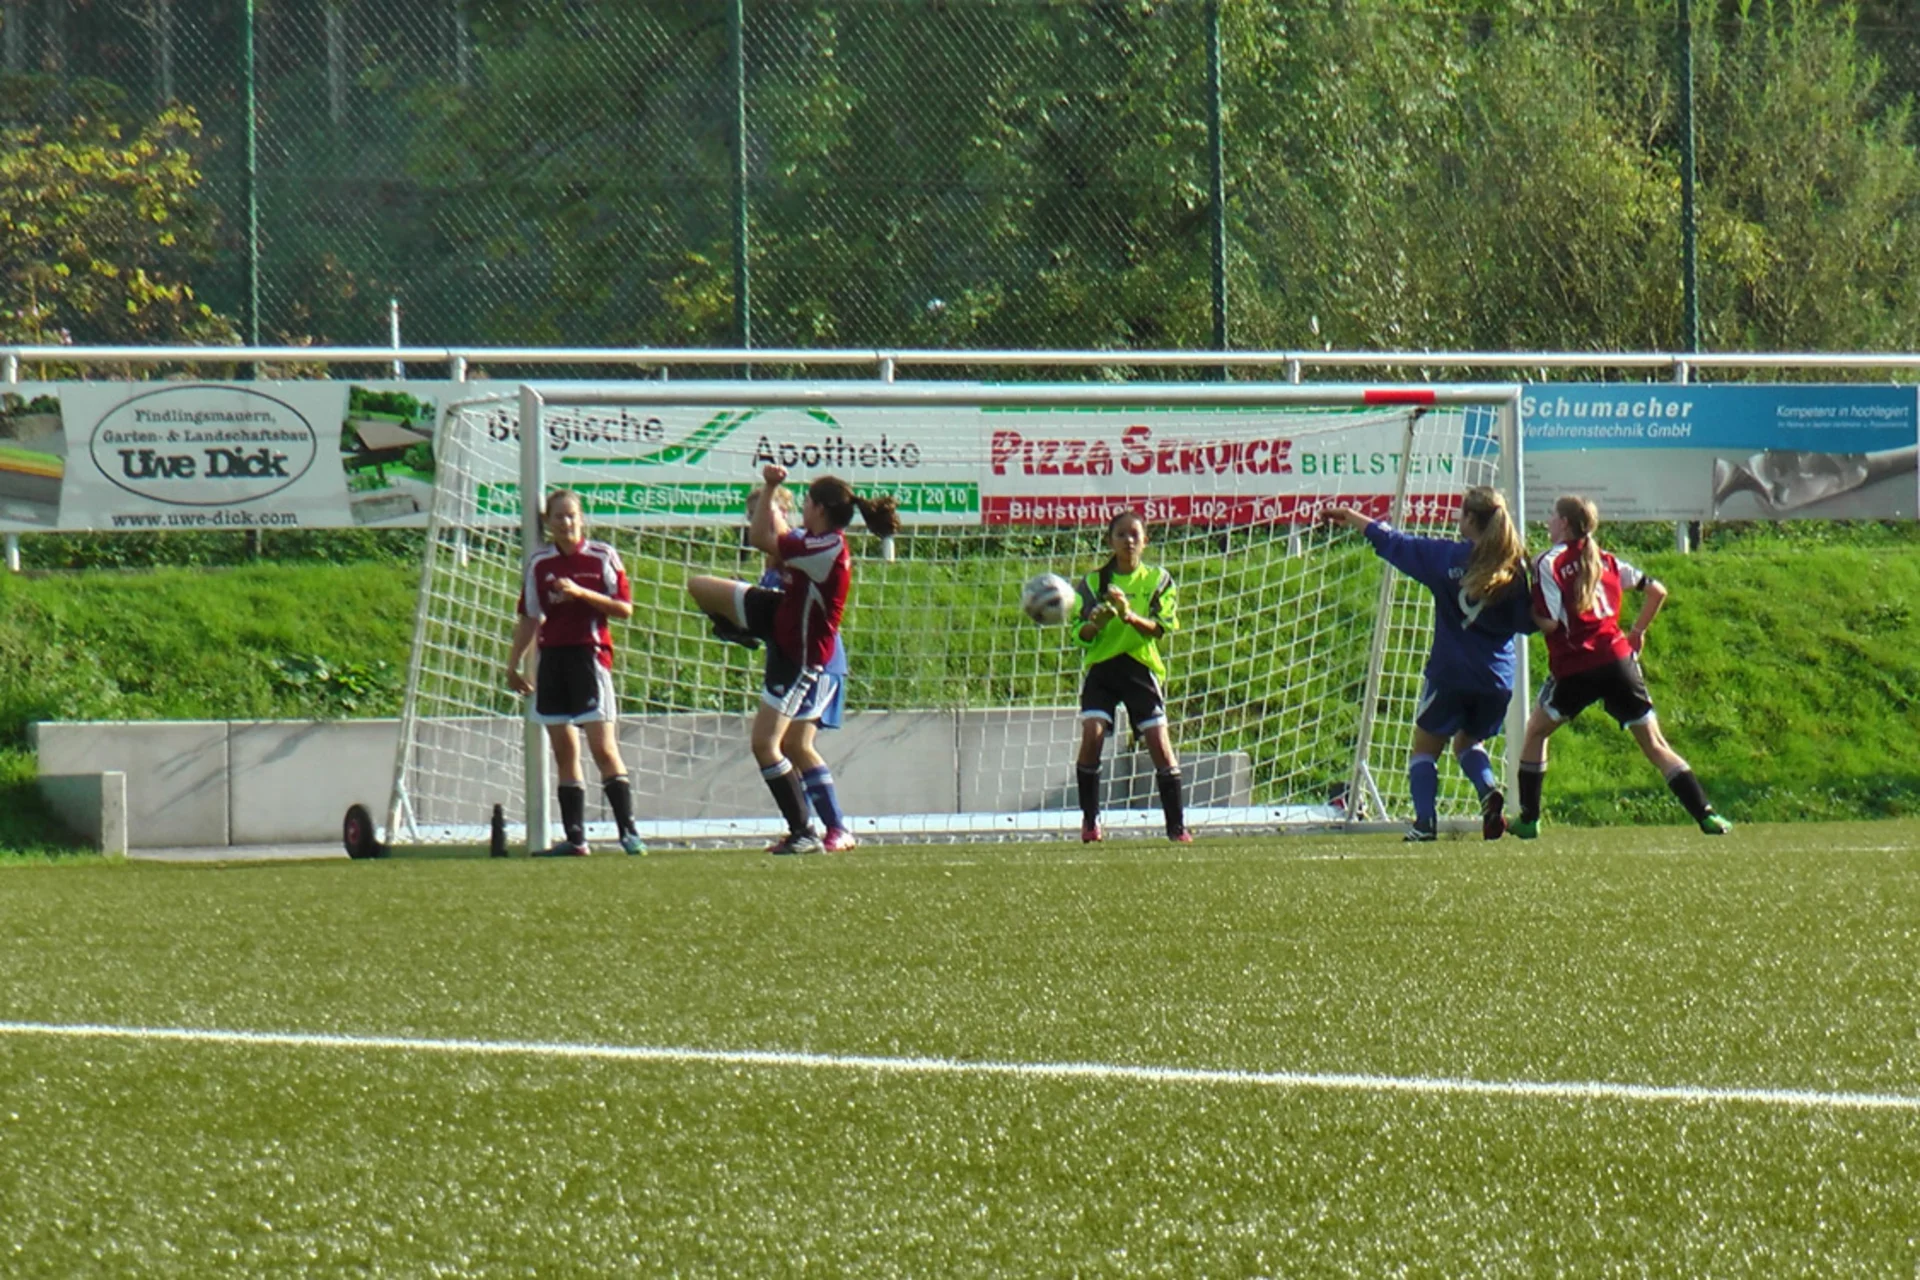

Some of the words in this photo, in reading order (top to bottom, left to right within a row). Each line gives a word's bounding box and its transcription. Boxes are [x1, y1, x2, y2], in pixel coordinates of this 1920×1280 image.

[1521, 396, 1693, 418] Schumacher
[135, 408, 277, 426] Findlingsmauern,
[103, 430, 163, 444] Garten-
[166, 431, 179, 443] &
[185, 429, 309, 444] Landschaftsbau
[488, 408, 664, 451] Bgische
[1647, 422, 1692, 438] GmbH
[753, 433, 921, 470] Apotheke
[118, 450, 196, 480] Uwe
[204, 448, 289, 478] Dick
[112, 509, 298, 528] www.uwe-dick.com
[1145, 502, 1182, 519] Str.
